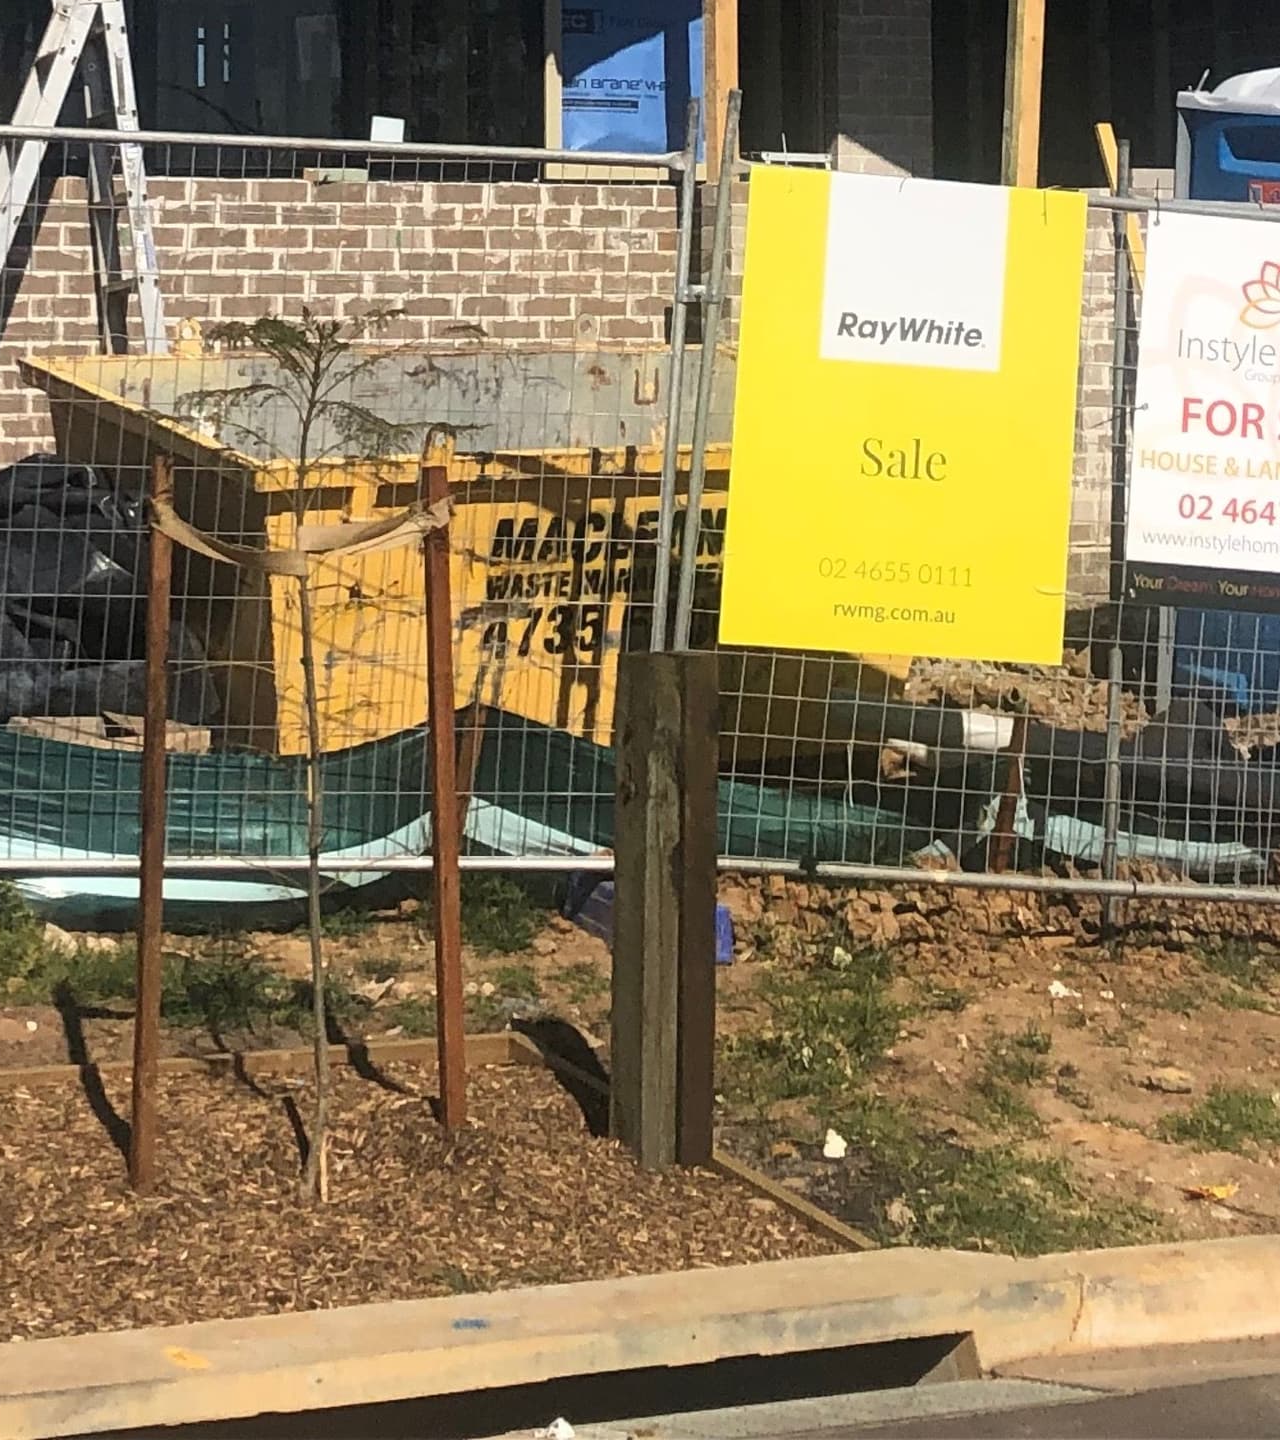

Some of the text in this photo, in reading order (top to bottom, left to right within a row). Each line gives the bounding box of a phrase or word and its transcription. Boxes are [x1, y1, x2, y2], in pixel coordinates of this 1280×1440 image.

[836, 311, 984, 348] RayWhite
[1177, 328, 1277, 372] Instyle
[1181, 397, 1266, 440] FOR
[860, 438, 949, 482] Sale
[1140, 449, 1218, 477] HOUSE
[1223, 456, 1241, 478] &
[1178, 493, 1214, 521] 02
[486, 569, 572, 600] WASTE
[819, 557, 973, 588] 02 4655 0111
[1133, 571, 1164, 591] Your
[1217, 578, 1249, 597] Your
[833, 602, 956, 624] rwmg.com.au
